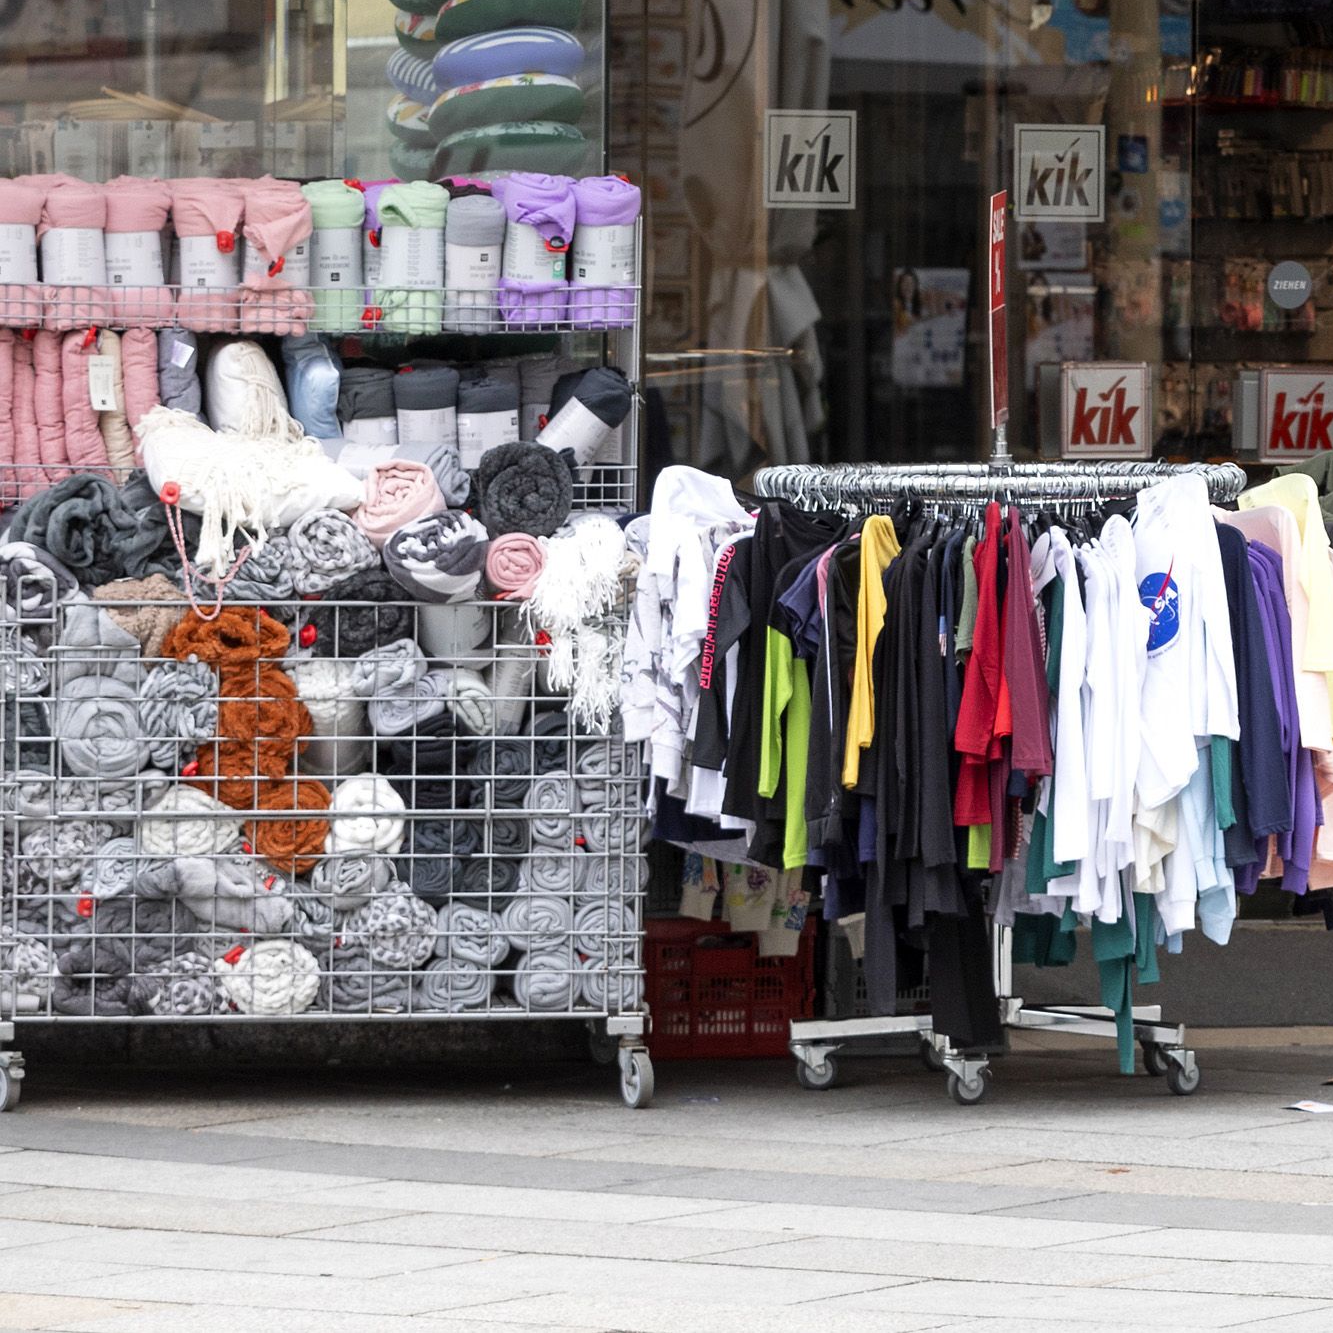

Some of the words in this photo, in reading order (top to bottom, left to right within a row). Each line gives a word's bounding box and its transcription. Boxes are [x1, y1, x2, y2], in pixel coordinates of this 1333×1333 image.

[775, 123, 841, 194] kik
[1025, 138, 1093, 208] kik
[1273, 278, 1307, 291] ZIEHEN
[1071, 375, 1138, 448] kik
